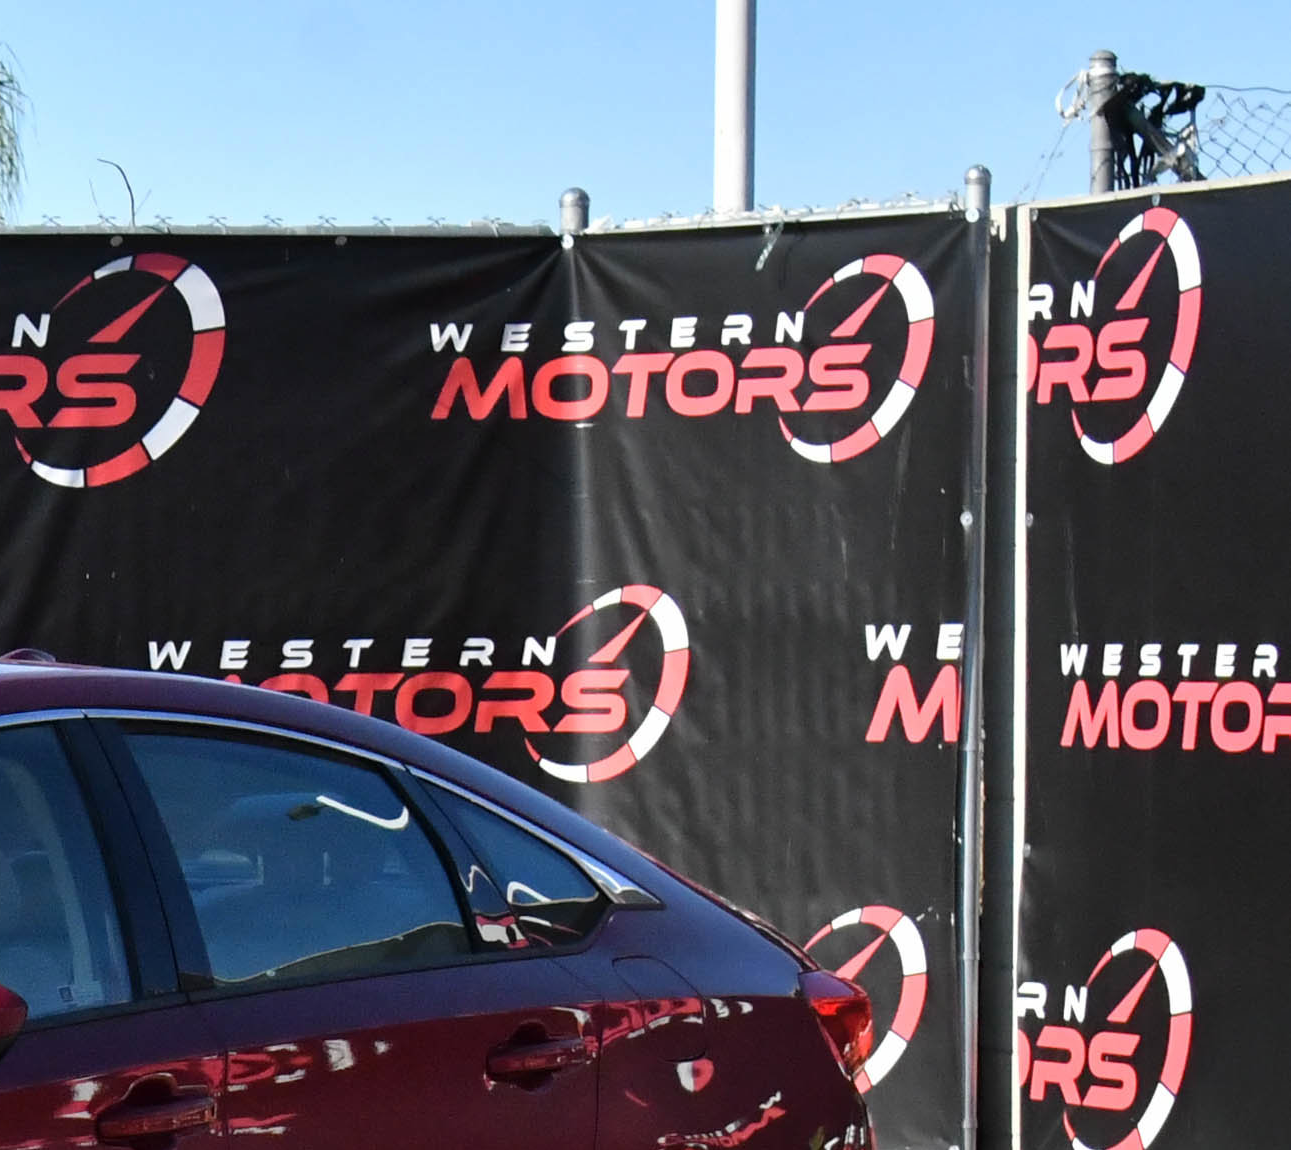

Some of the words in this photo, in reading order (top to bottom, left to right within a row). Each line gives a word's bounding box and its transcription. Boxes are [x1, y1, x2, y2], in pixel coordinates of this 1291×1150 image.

[430, 311, 805, 352] WESTERN
[1027, 318, 1150, 404] RS
[431, 344, 873, 420] MOTORS
[148, 637, 557, 670] WESTERN
[1060, 644, 1279, 677] WESTER
[225, 668, 631, 735] TORS
[1019, 1025, 1141, 1112] RS
